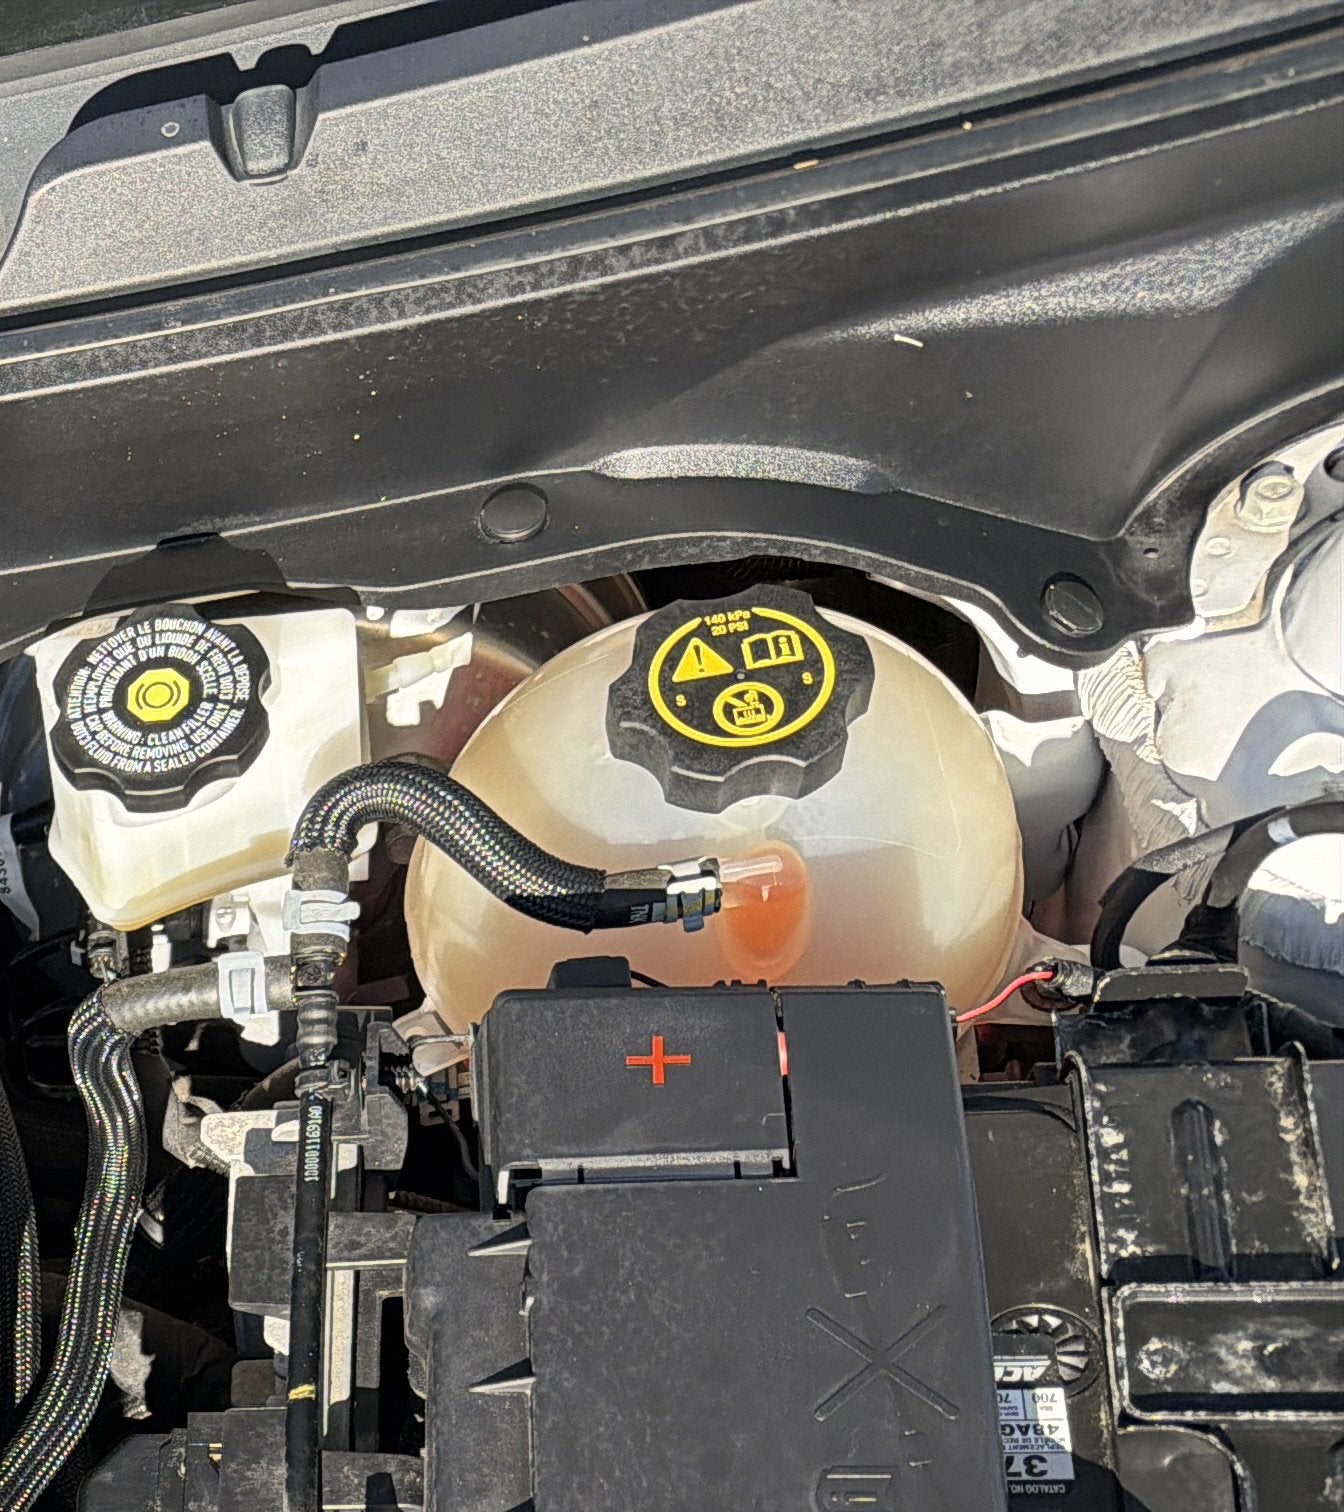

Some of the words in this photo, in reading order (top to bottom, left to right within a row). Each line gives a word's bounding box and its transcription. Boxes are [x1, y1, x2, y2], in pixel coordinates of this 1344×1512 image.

[704, 612, 726, 626] 140
[728, 610, 752, 622] kPa
[711, 625, 727, 637] 20
[728, 622, 749, 633] PSI
[87, 626, 136, 664] NETTOYER
[137, 621, 151, 634] LE
[155, 618, 207, 635] BOUCHON
[204, 627, 236, 652] AVANT
[228, 650, 245, 665] LA
[113, 641, 137, 659] QUE
[136, 635, 152, 648] DU
[155, 632, 195, 647] LIQUIDE
[195, 640, 212, 655] DE
[206, 647, 231, 674] FREIN
[99, 656, 138, 708] PROVENANT
[138, 645, 165, 662] D'UN
[167, 646, 202, 665] BIDON
[802, 671, 814, 685] S
[676, 694, 687, 707] S
[86, 714, 103, 733] CAP
[95, 728, 136, 758] BEFORE
[191, 722, 214, 745] USE
[206, 702, 231, 730] ONLY
[147, 728, 185, 746] CLEAN
[182, 701, 214, 736] FILLER
[84, 737, 113, 765] FLUID
[110, 755, 144, 774] FROM
[143, 761, 153, 774] A
[153, 750, 198, 774] SEALED
[304, 1105, 323, 1182] 1000011691A0
[995, 1366, 1047, 1382] AC
[1032, 1392, 1057, 1403] 700
[1001, 1423, 1059, 1436] 48AG
[1025, 1484, 1065, 1494] CATALOG
